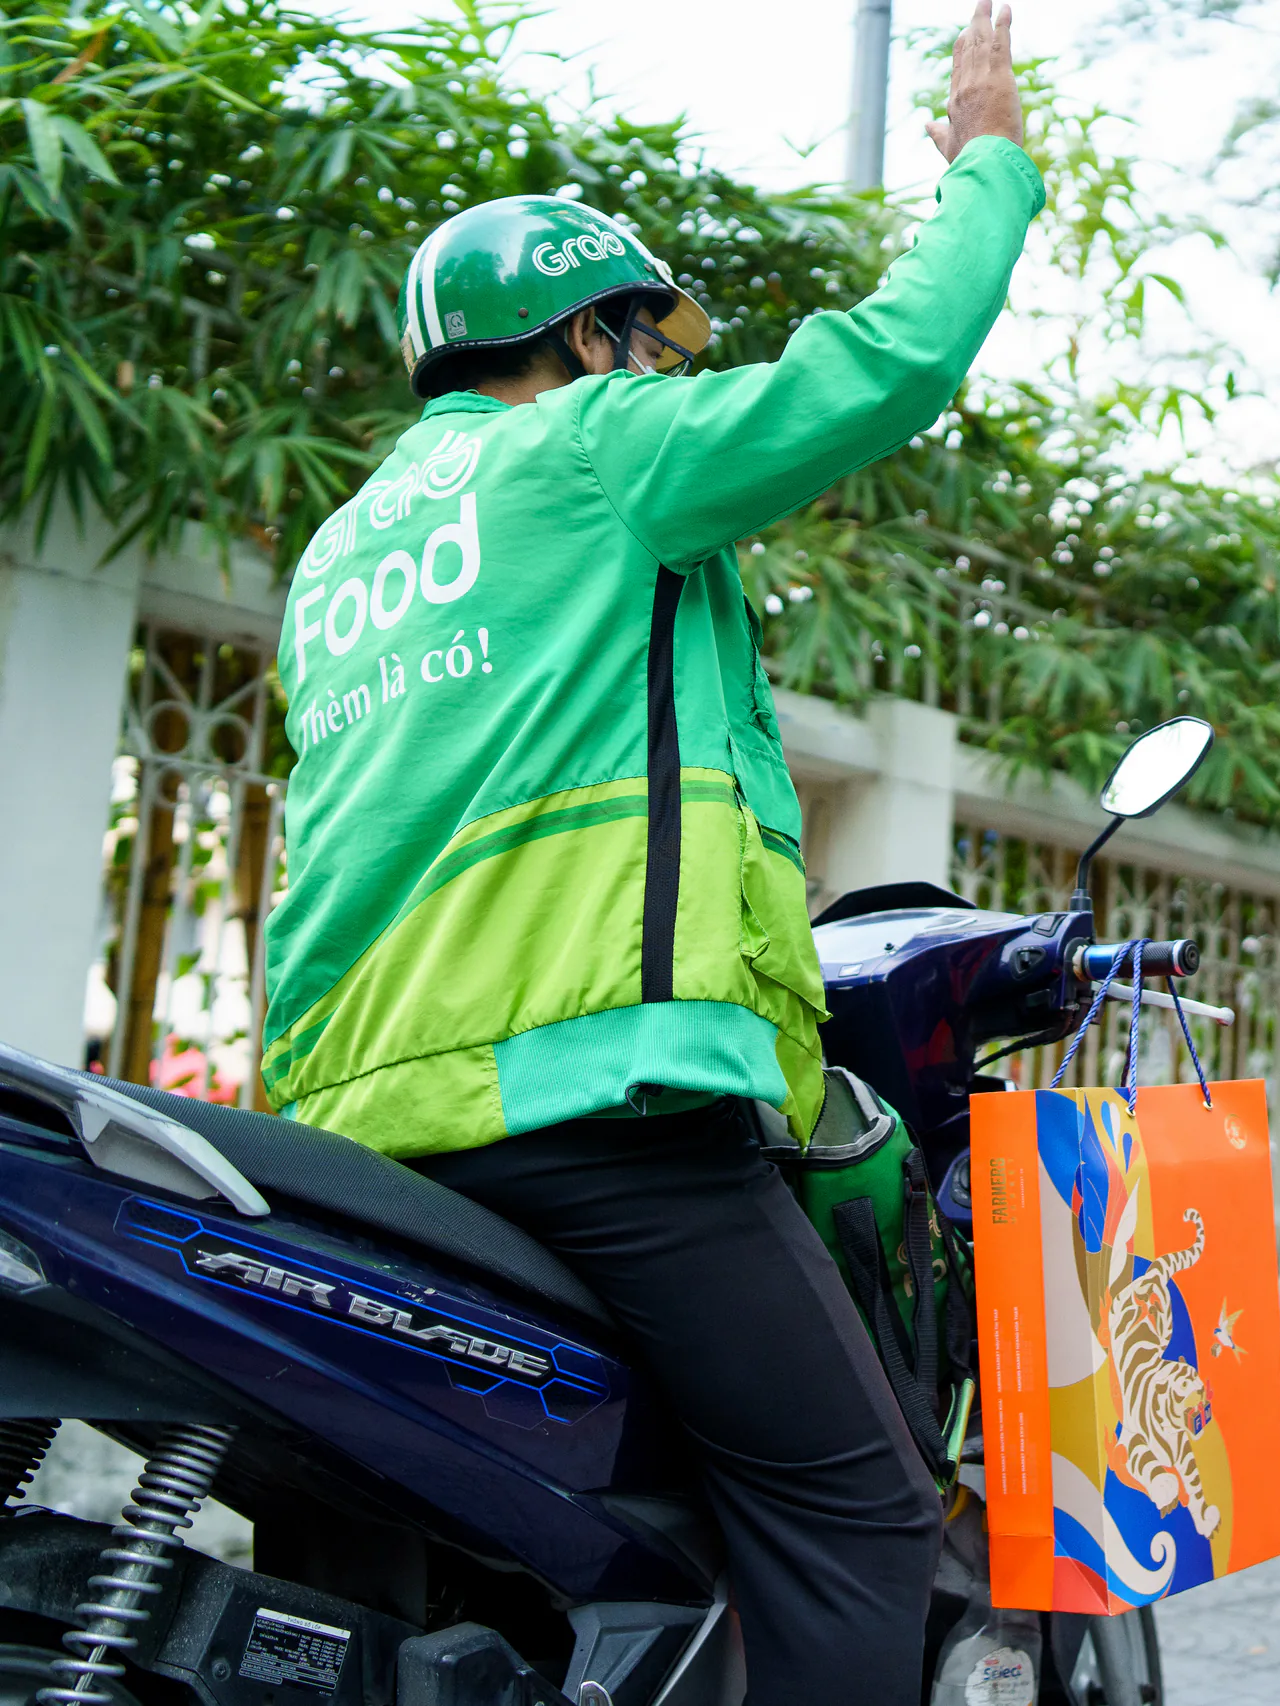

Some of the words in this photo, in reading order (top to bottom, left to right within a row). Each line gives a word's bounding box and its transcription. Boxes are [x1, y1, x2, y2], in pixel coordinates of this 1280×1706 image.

[532, 223, 626, 276] Grab
[302, 430, 482, 578] Grab
[294, 491, 481, 684] Food
[379, 652, 406, 704] là
[420, 627, 493, 683] có!
[990, 1157, 1008, 1225] FARMERS
[195, 1250, 336, 1308] AIR
[348, 1292, 549, 1377] BLADE
